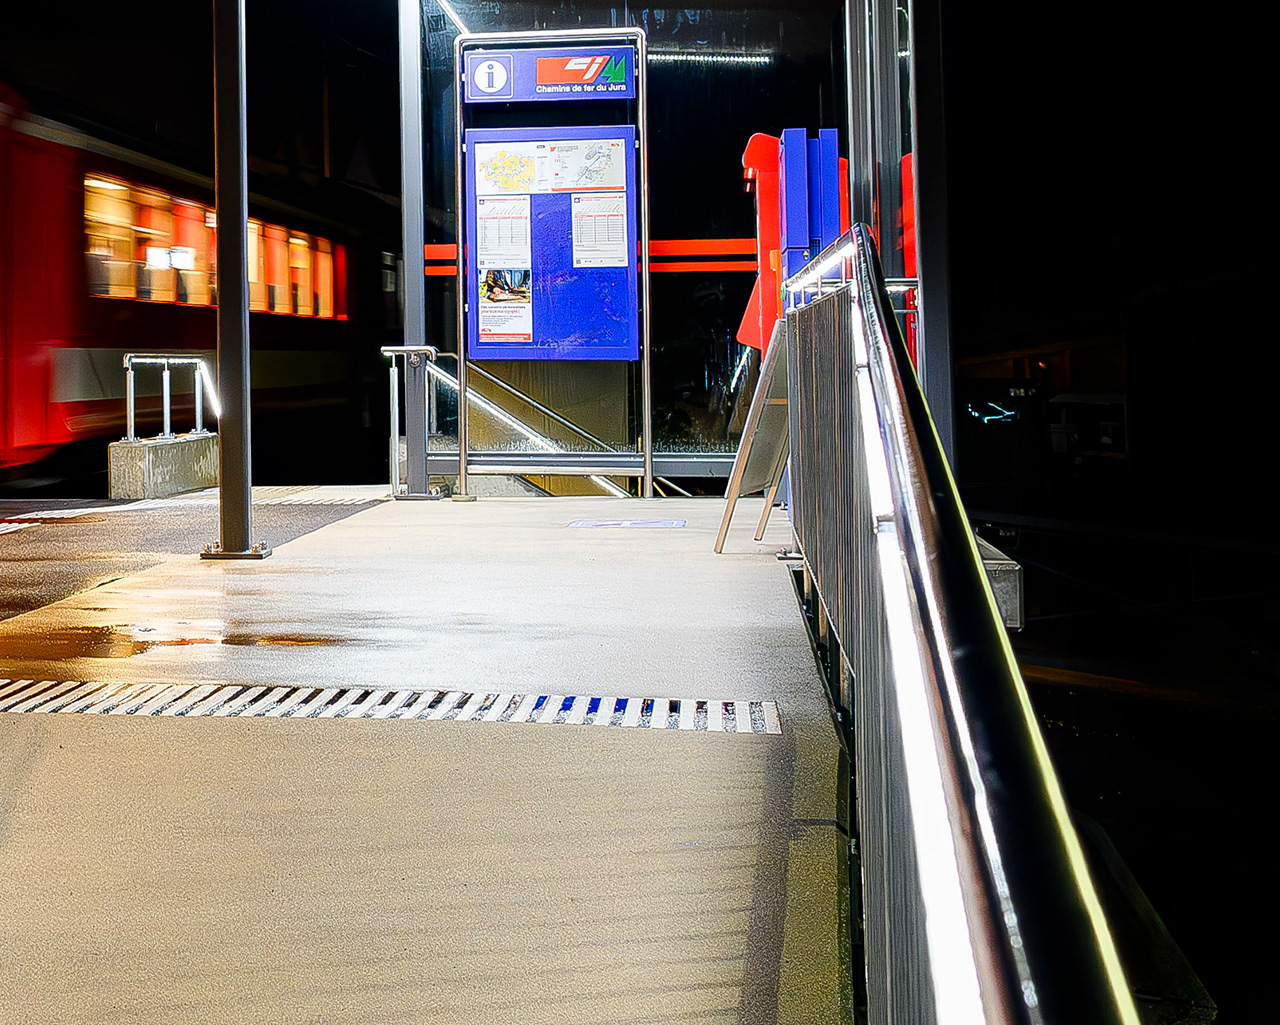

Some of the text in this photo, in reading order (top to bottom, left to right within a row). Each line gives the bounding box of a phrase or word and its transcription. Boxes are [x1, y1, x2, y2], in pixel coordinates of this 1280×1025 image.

[536, 85, 570, 93] Chemins
[572, 84, 582, 92] de
[583, 84, 595, 92] fer
[608, 83, 627, 91] Jura
